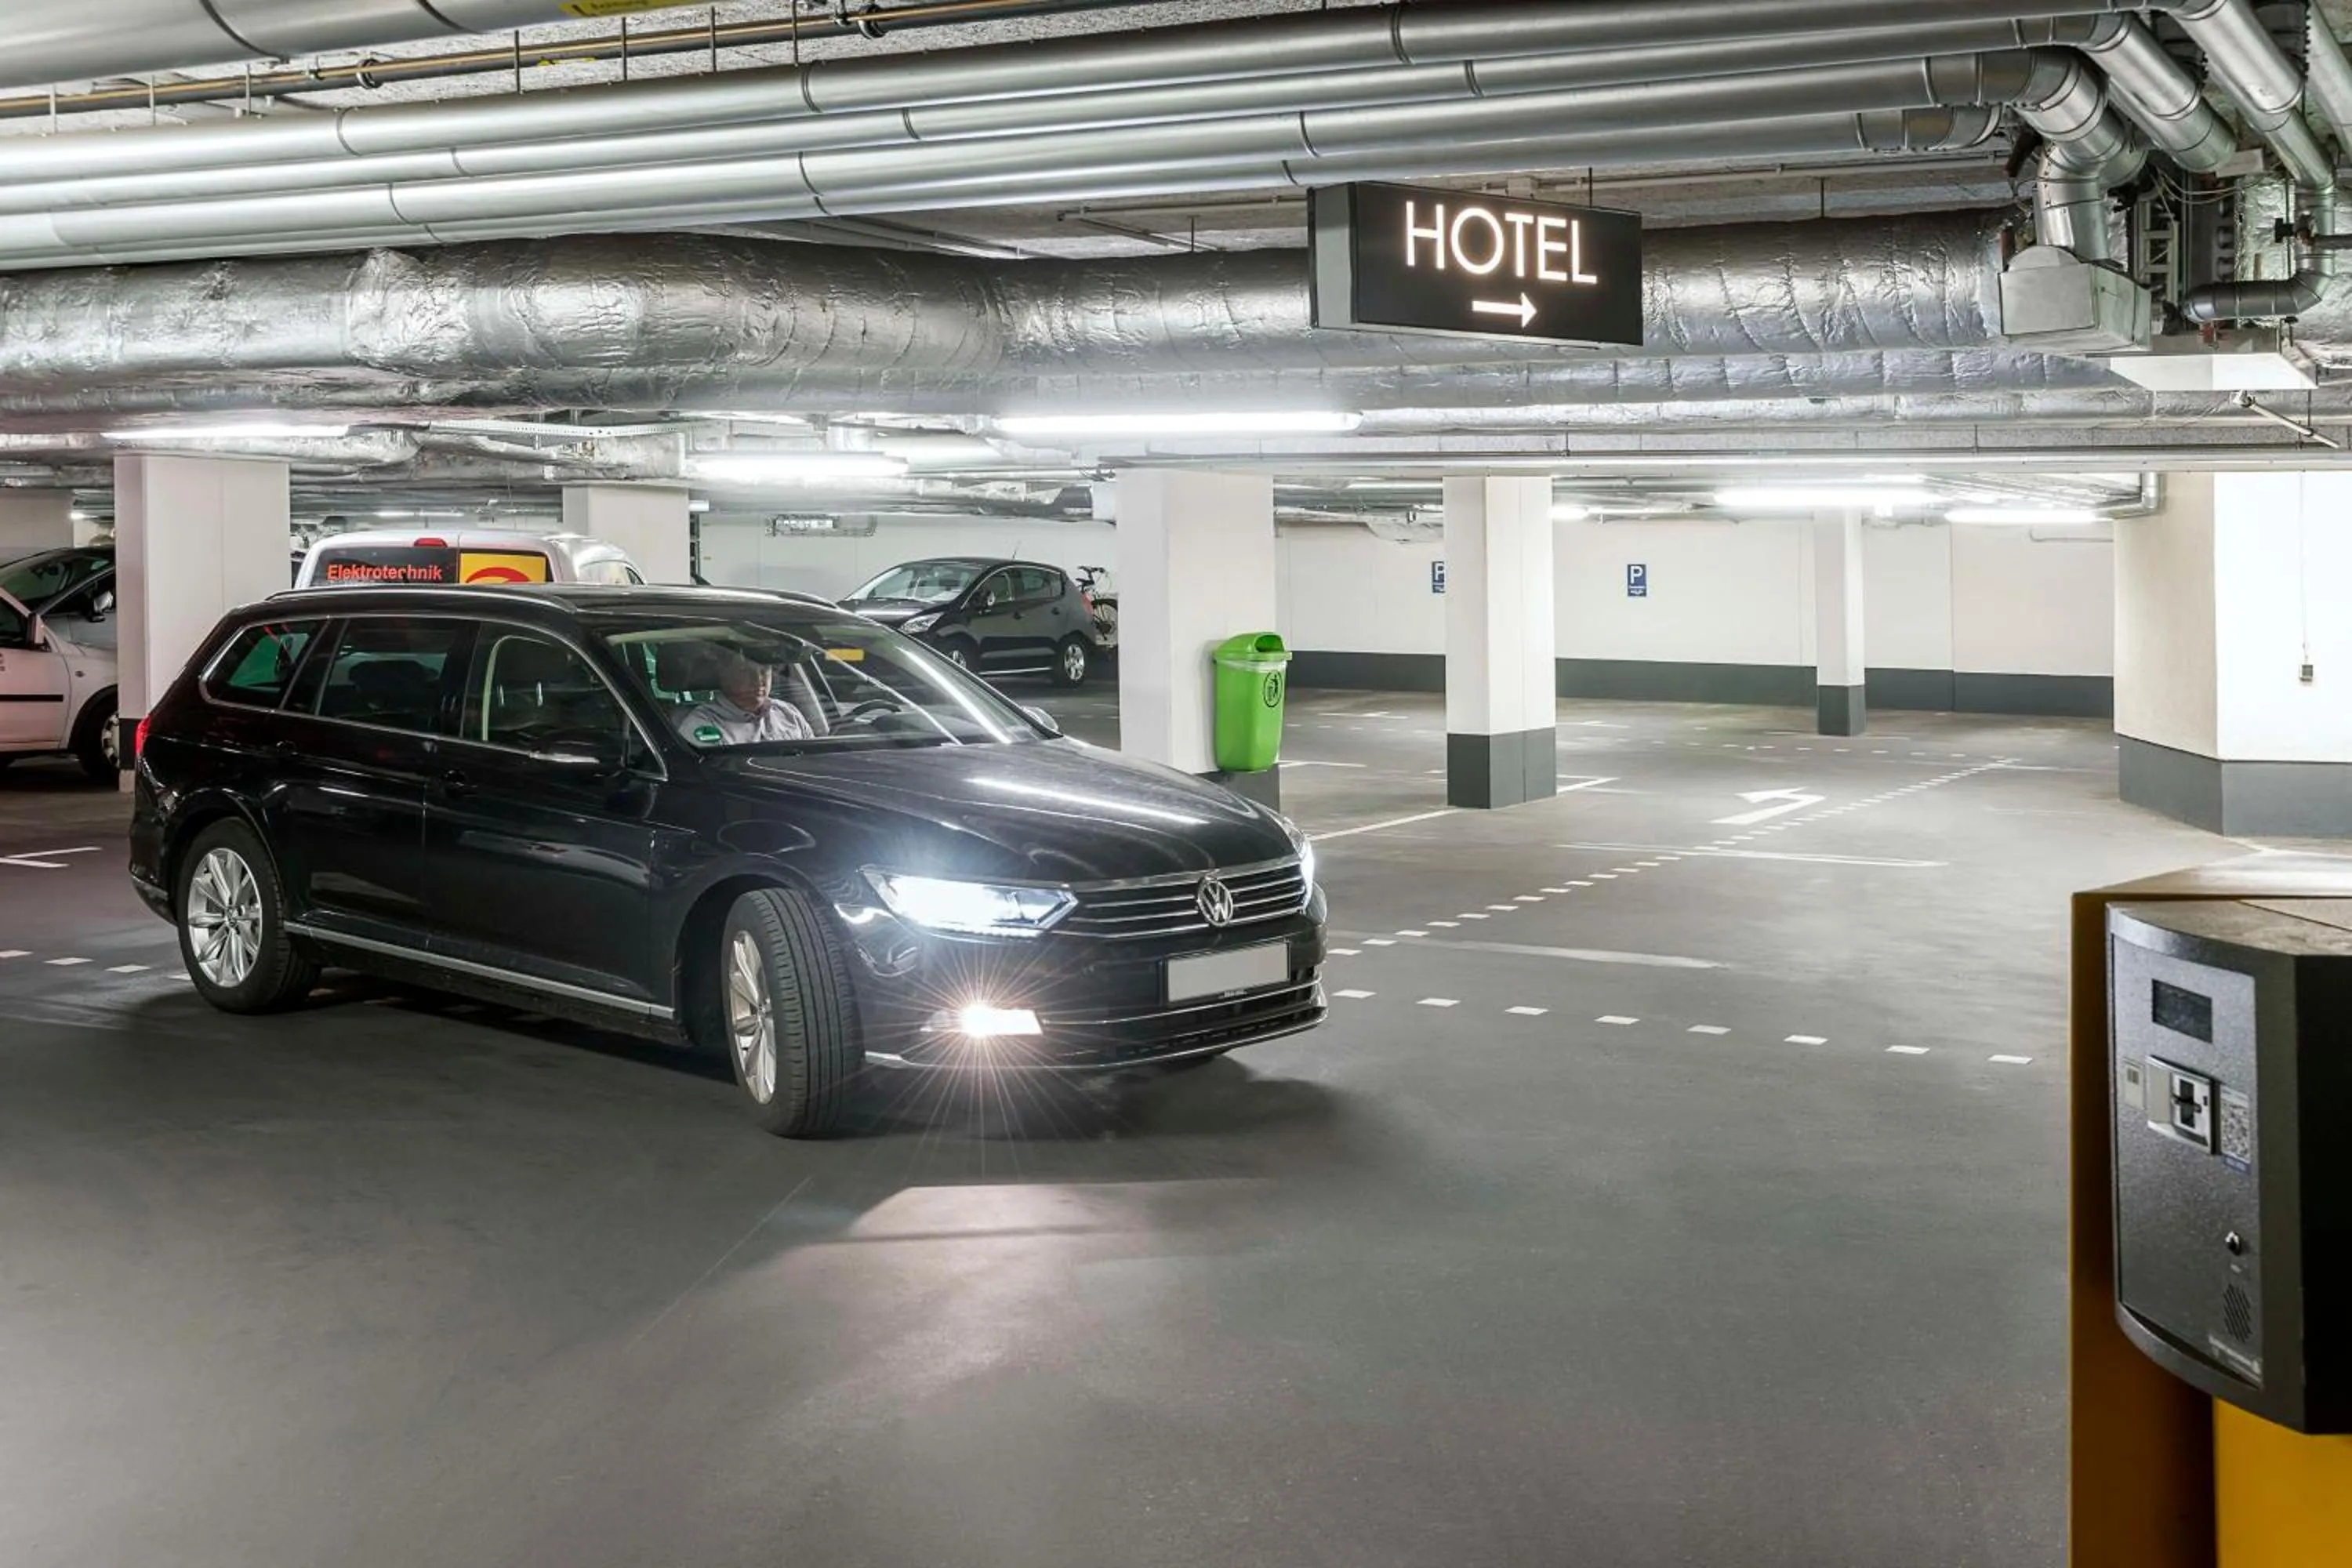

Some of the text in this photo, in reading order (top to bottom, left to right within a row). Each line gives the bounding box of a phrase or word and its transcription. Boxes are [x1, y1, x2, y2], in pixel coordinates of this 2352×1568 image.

[1406, 200, 1598, 285] HOTEL
[327, 564, 443, 580] Elektrotechnik
[1631, 565, 1643, 584] P
